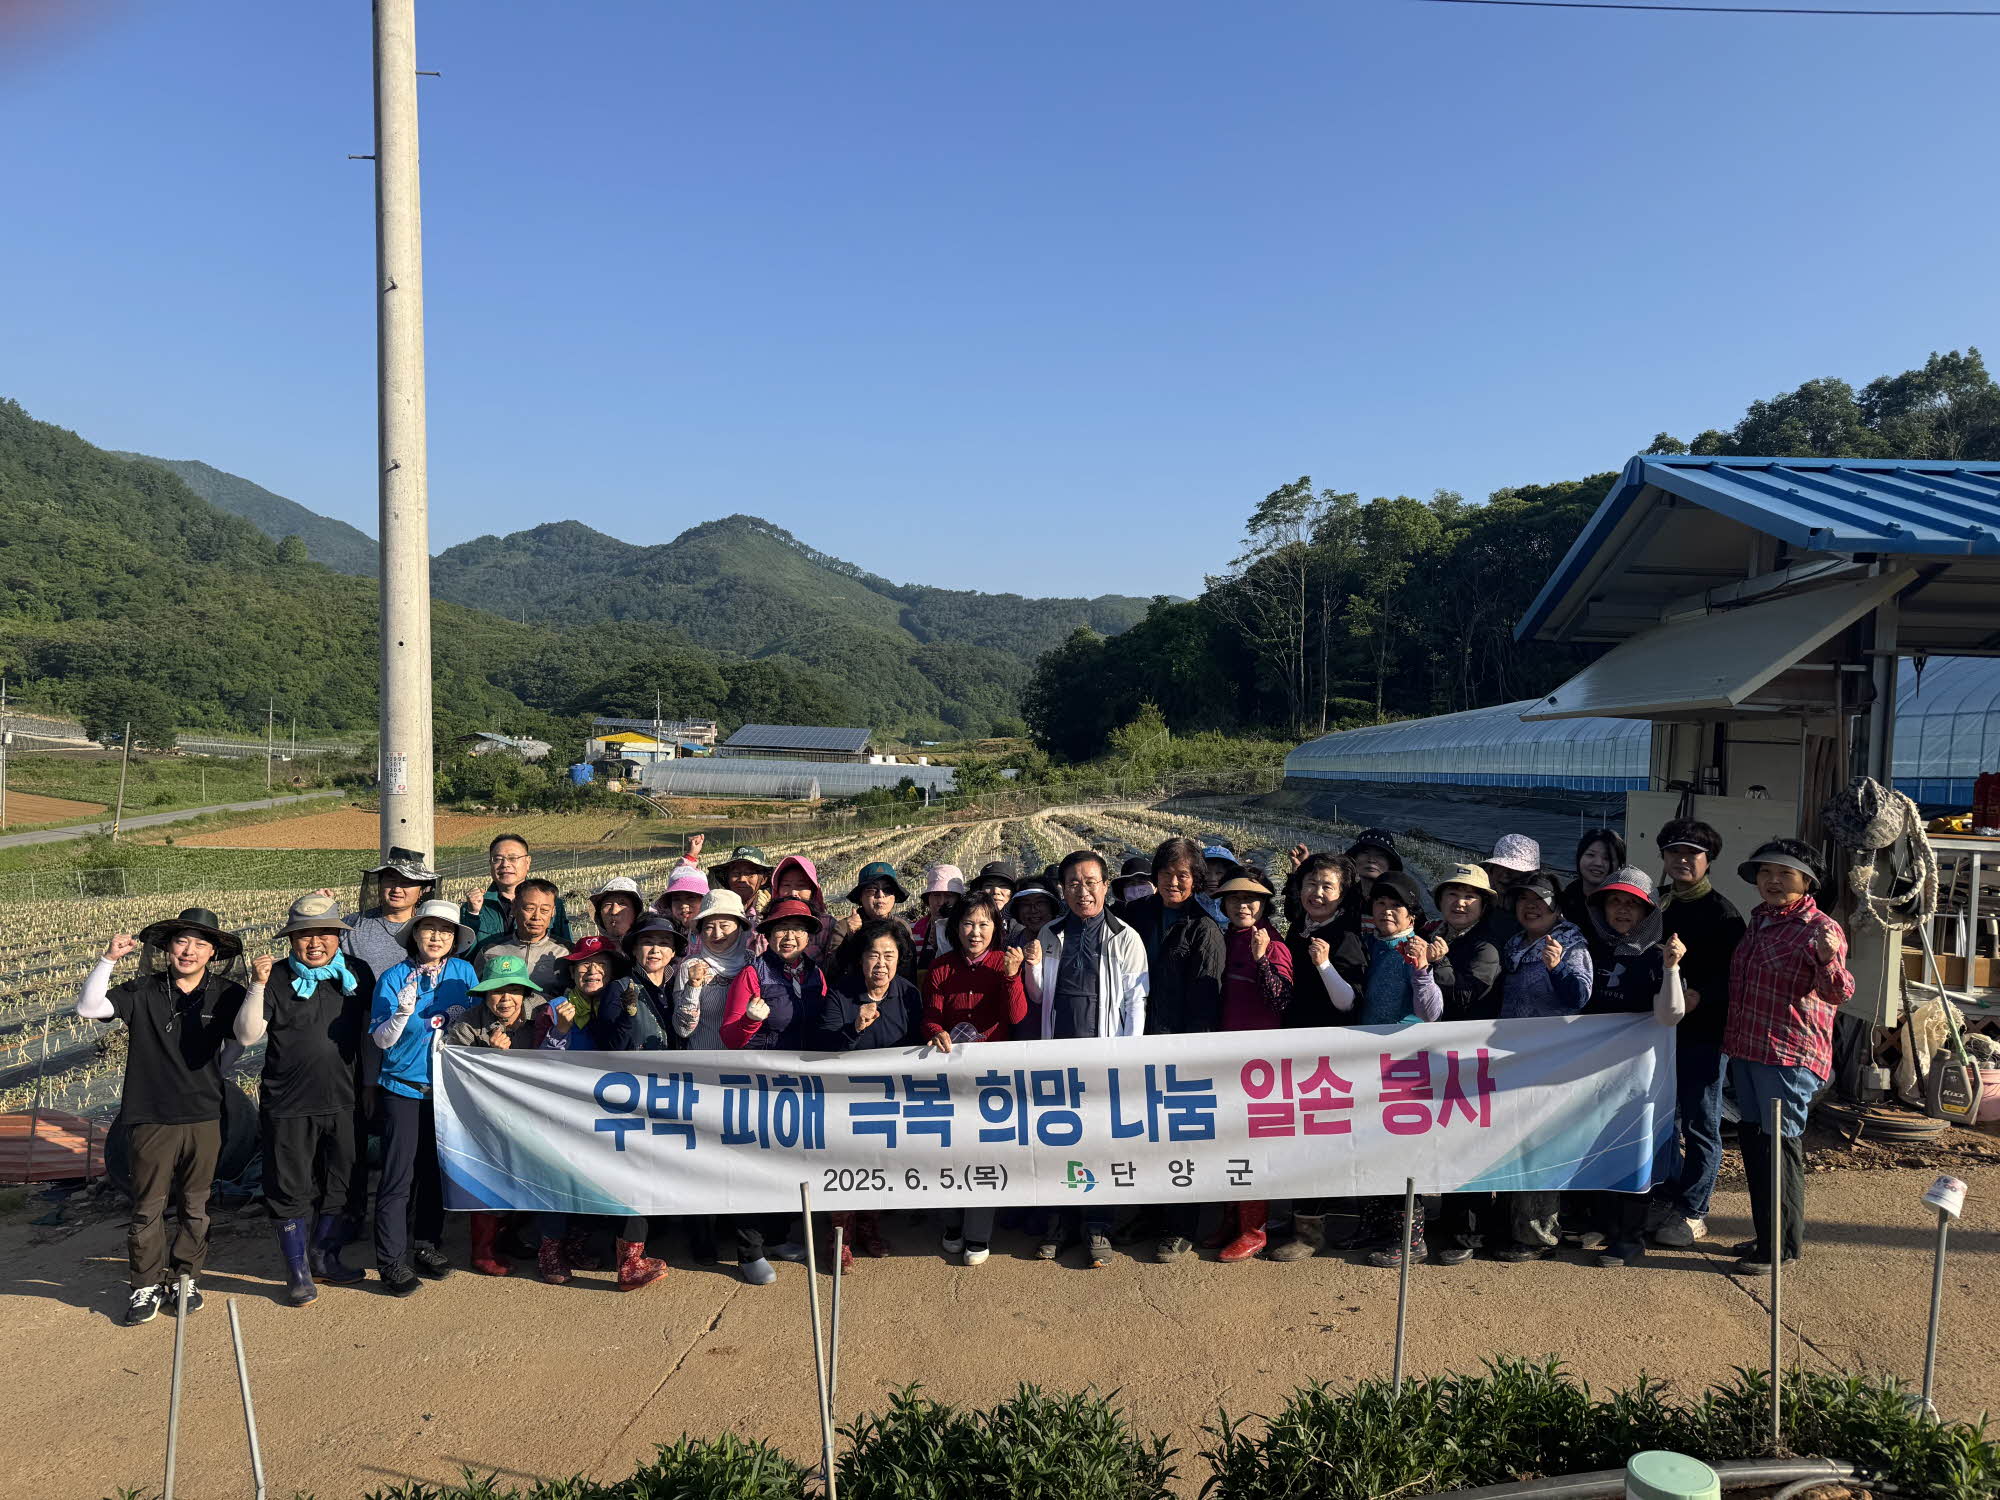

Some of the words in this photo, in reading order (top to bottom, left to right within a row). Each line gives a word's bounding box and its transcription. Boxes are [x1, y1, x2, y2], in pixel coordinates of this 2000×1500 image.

[593, 1071, 700, 1151] 우박
[719, 1074, 825, 1149] 피해
[848, 1074, 954, 1148] 극복
[976, 1069, 1085, 1146] 희망
[1108, 1064, 1217, 1142] 나눔
[1240, 1055, 1354, 1138] 일손
[1378, 1048, 1497, 1135] 봉사
[823, 1168, 894, 1192] 2025.
[904, 1167, 928, 1191] 6.
[939, 1164, 1008, 1192] 5.(목)
